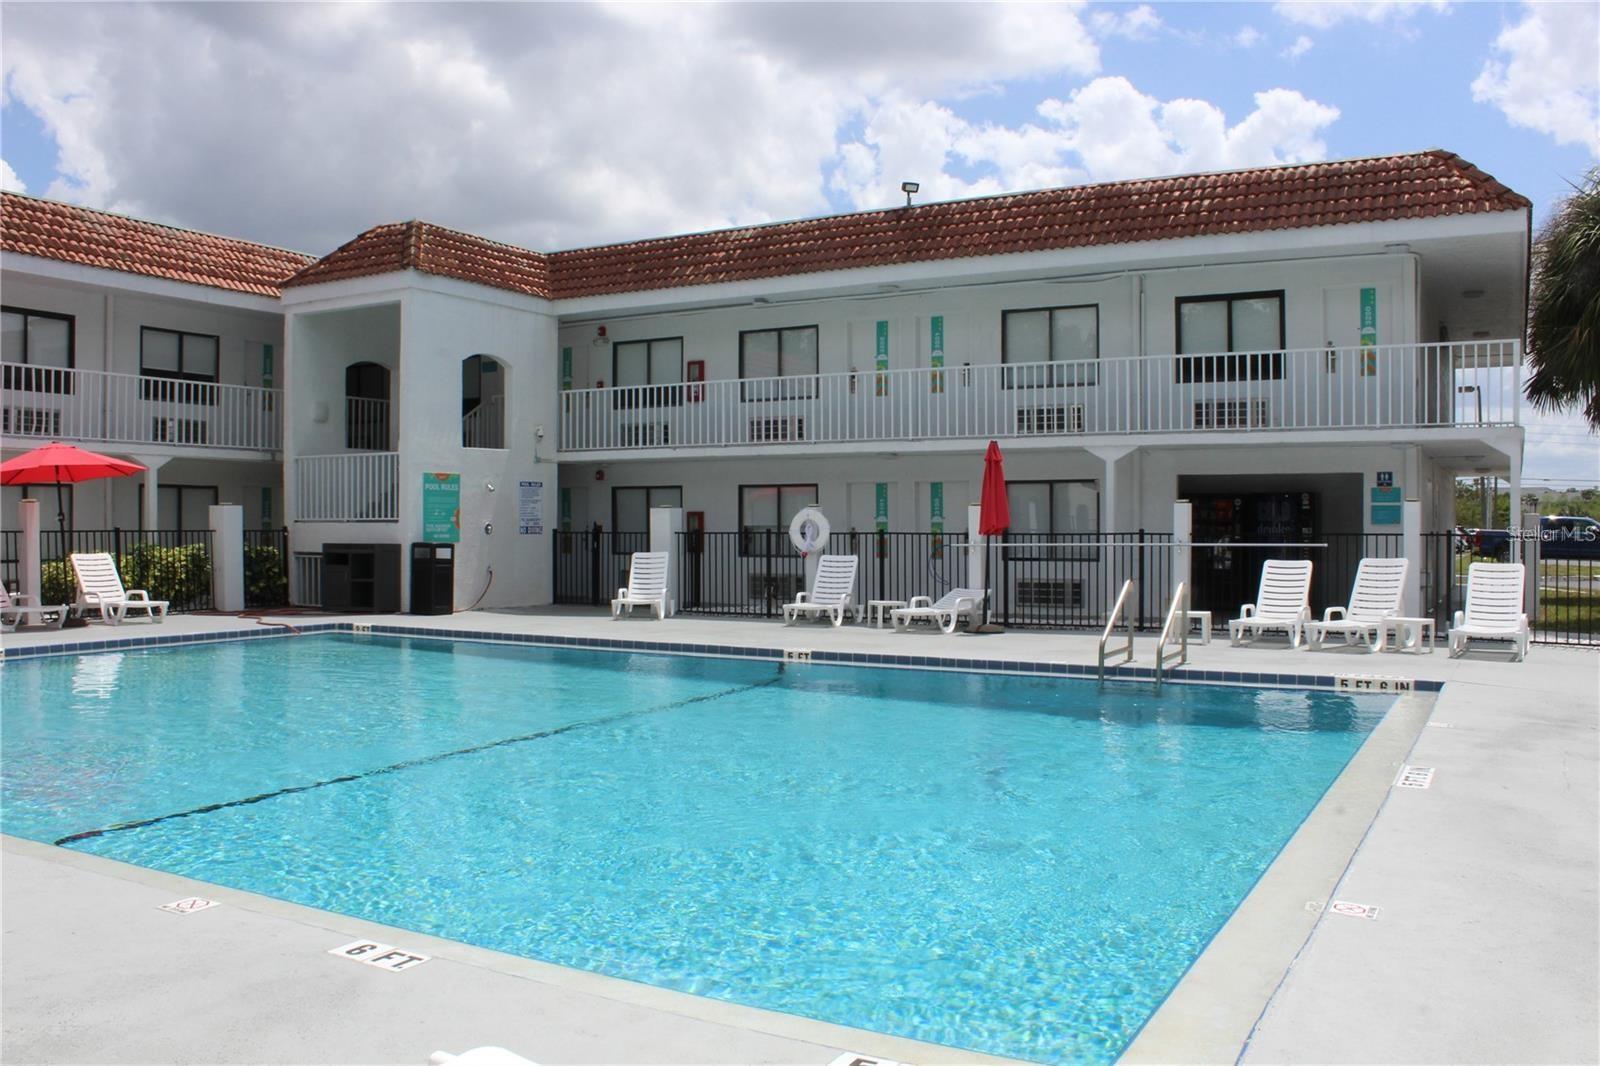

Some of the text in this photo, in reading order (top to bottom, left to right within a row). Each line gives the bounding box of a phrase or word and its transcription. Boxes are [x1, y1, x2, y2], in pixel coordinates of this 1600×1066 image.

[797, 651, 810, 661] FT
[1341, 680, 1349, 688] 5
[1356, 681, 1372, 689] FT
[1395, 682, 1410, 690] IN
[345, 944, 377, 956] 6
